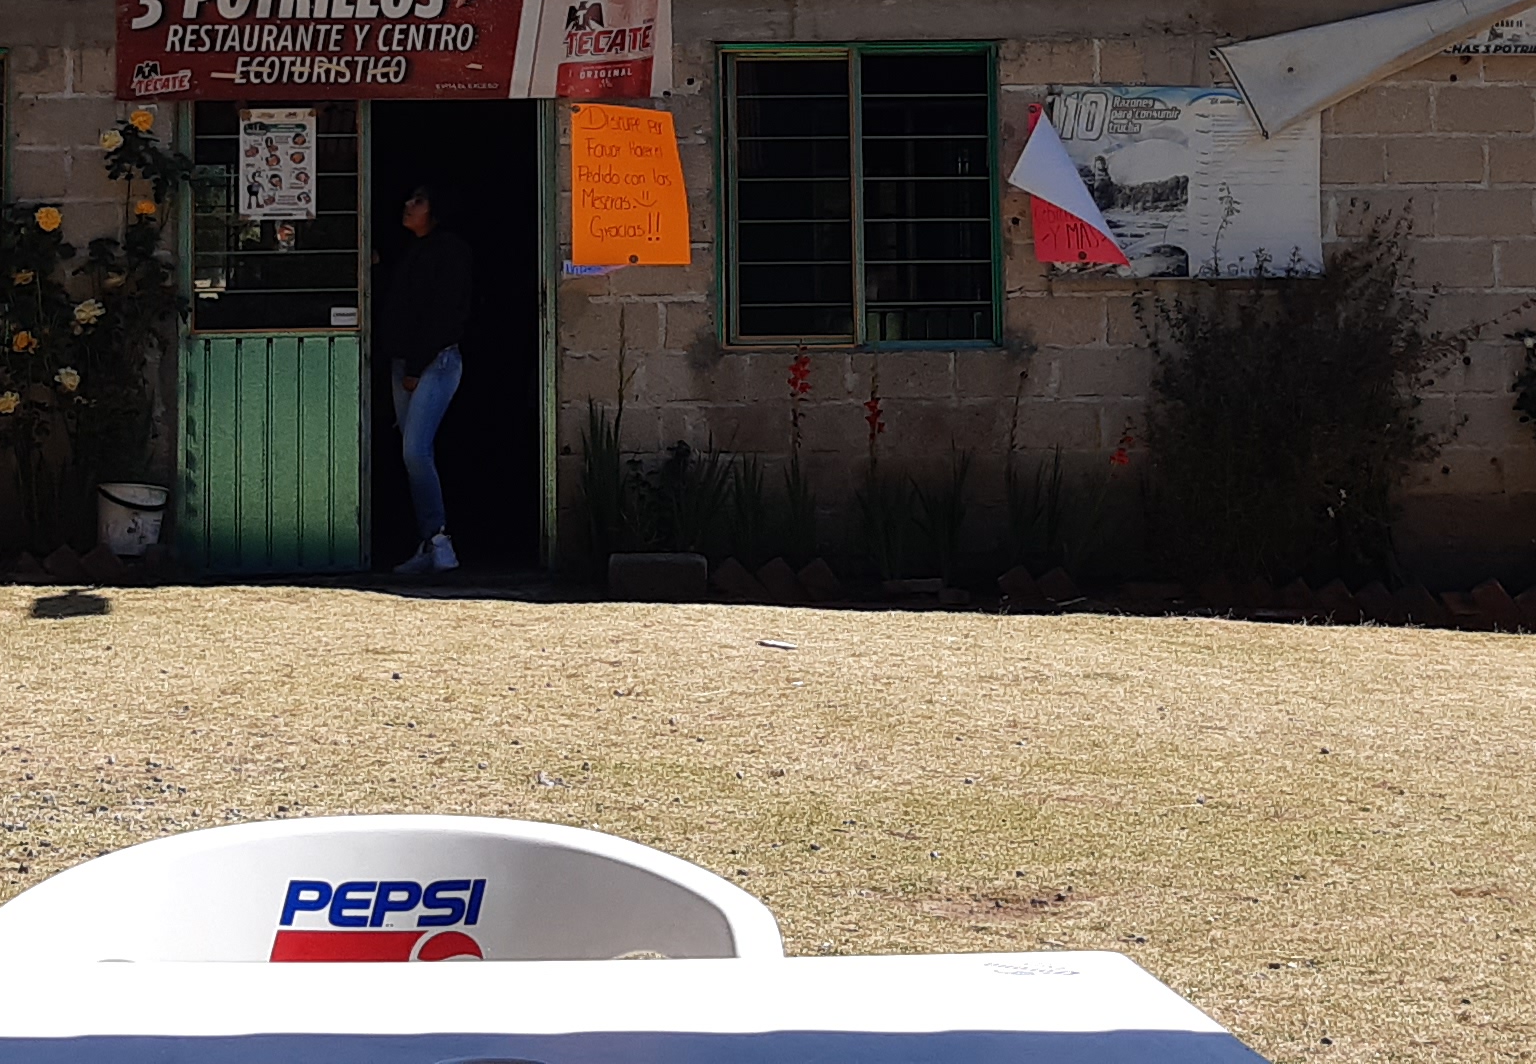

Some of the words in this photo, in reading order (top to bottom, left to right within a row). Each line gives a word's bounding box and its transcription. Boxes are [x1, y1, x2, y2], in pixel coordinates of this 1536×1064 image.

[165, 23, 344, 53] RESTAURANTE
[353, 24, 372, 52] Y
[377, 23, 475, 53] CENTRO
[565, 25, 652, 56] TECATE
[233, 55, 407, 85] ECOTURISTICO
[579, 68, 633, 80] ORIGINAL
[135, 75, 189, 94] TECATE
[1113, 96, 1155, 108] Razones
[1059, 91, 1108, 142] 10
[1111, 108, 1133, 121] para
[1134, 107, 1181, 120] consumir
[1108, 121, 1141, 134] trucha
[578, 164, 621, 185] Pedido
[625, 175, 646, 186] con
[279, 878, 486, 928] PEPSI
